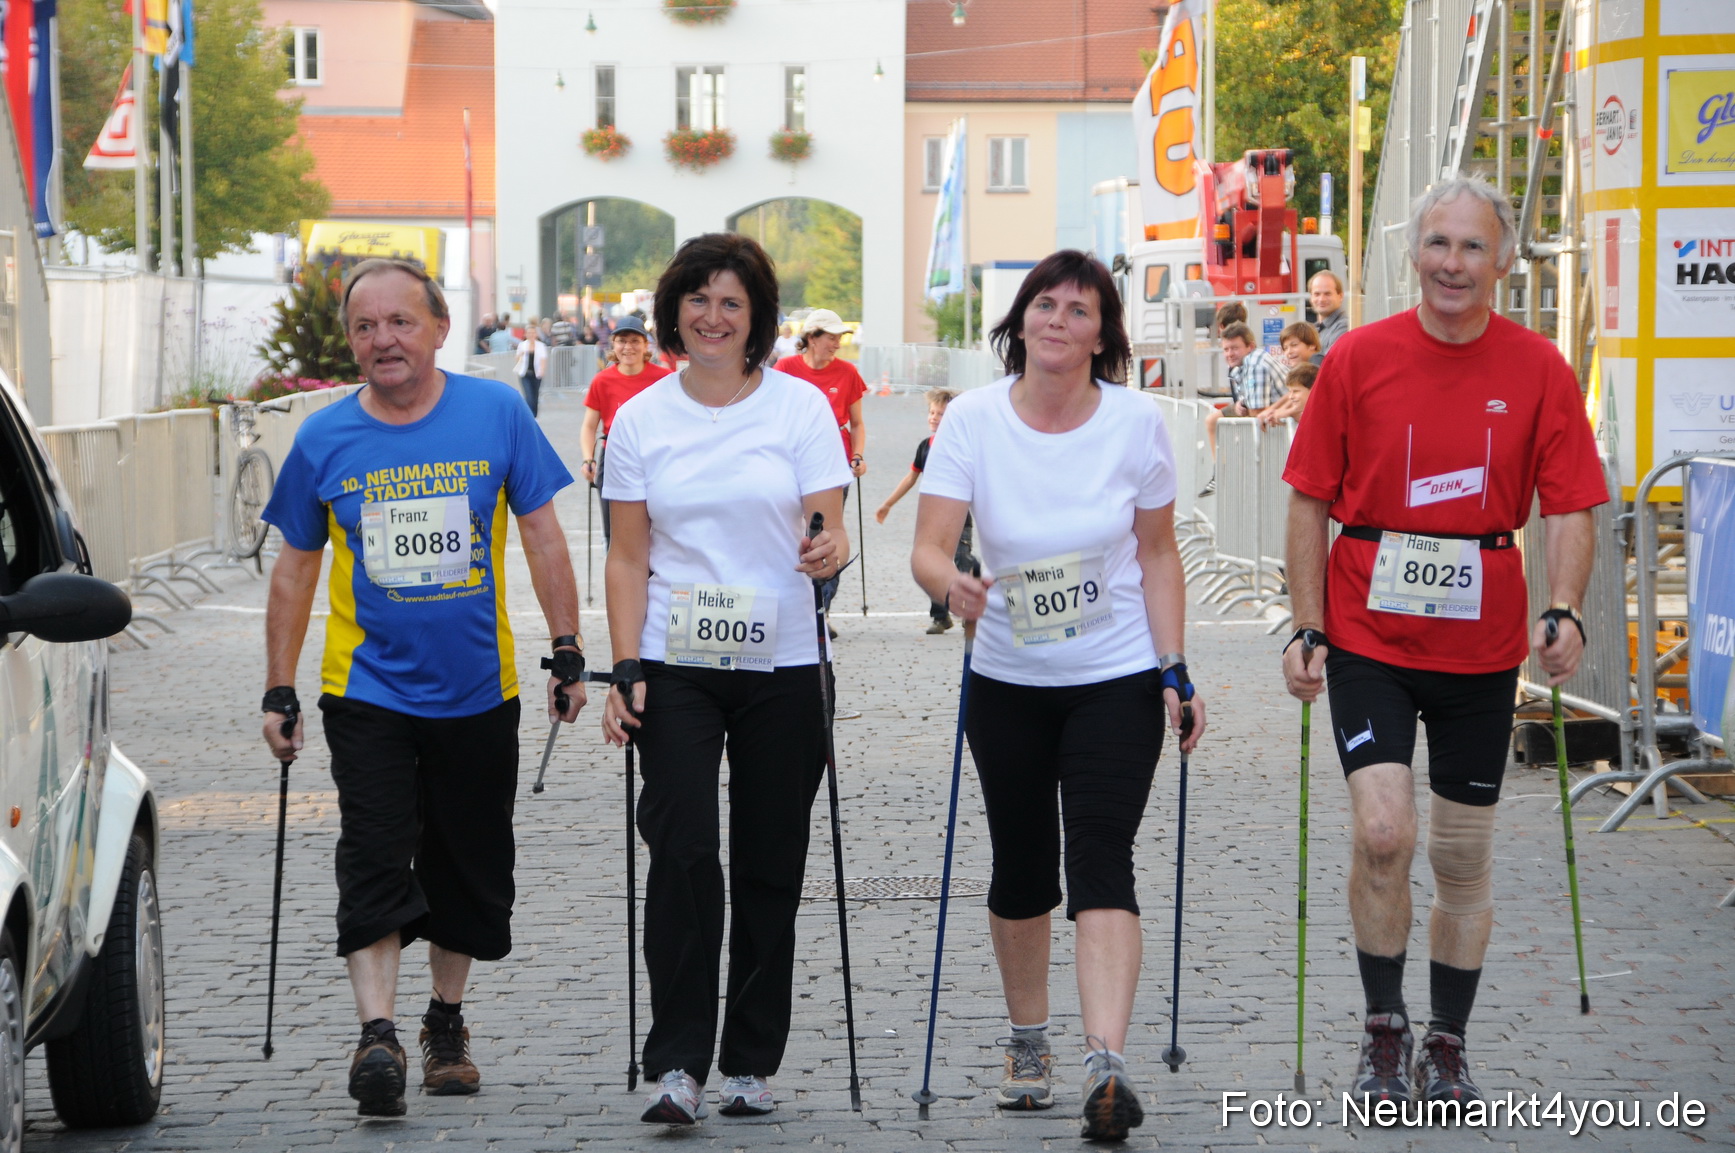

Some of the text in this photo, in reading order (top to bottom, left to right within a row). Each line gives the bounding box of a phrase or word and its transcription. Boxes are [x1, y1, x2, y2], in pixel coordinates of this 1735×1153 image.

[341, 460, 490, 493] 10. NEUMARKTER
[363, 478, 468, 504] STADTLAUF
[1430, 479, 1463, 495] DEHN
[390, 508, 429, 524] Franz
[367, 535, 375, 547] N
[394, 530, 461, 557] 8088
[1406, 534, 1440, 553] Hans
[1379, 554, 1388, 567] N
[432, 567, 468, 578] PFLEIDERER
[1025, 566, 1065, 584] Maria
[1403, 560, 1473, 589] 8025
[697, 590, 735, 609] Heike
[1007, 596, 1016, 607] N
[1033, 580, 1099, 616] 8079
[1437, 603, 1478, 613] PFLEIDERER
[670, 613, 679, 626] N
[697, 617, 766, 643] 8005
[731, 656, 772, 666] PFLEIDERER
